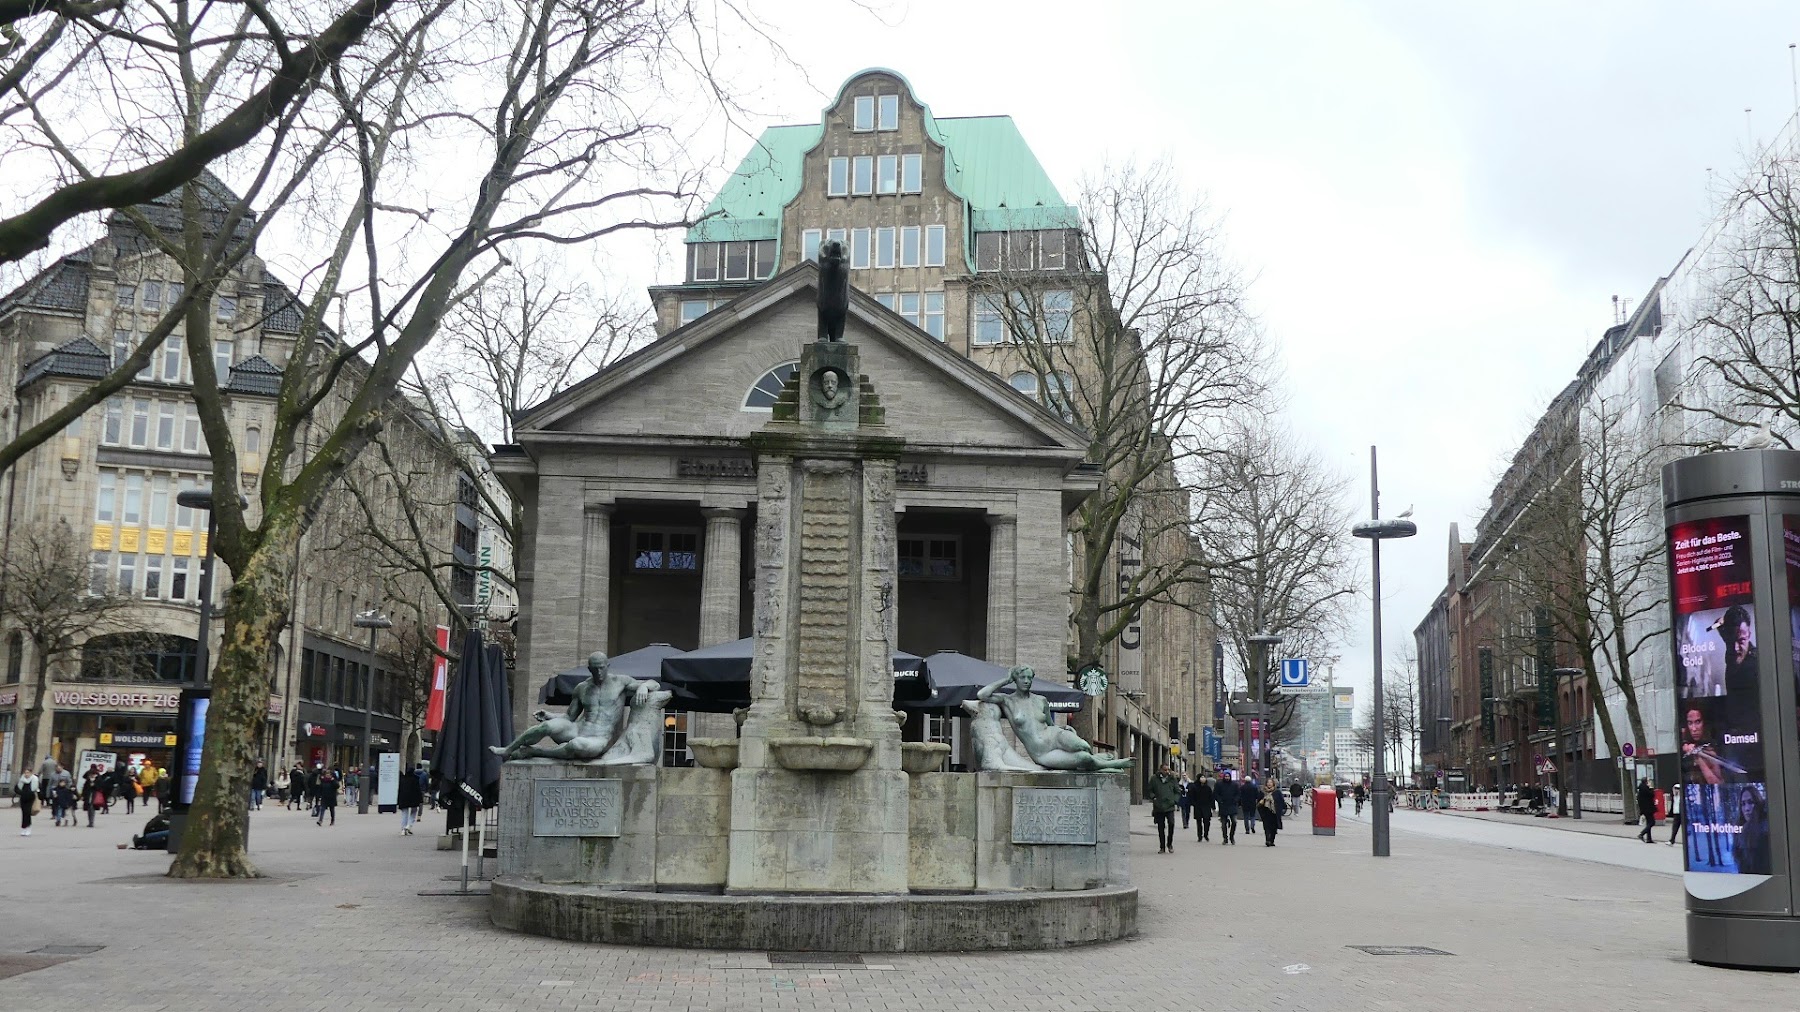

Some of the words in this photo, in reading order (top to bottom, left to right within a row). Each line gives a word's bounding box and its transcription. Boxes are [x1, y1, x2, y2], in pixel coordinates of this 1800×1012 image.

[1675, 540, 1690, 550] Zeit
[1690, 537, 1701, 547] für
[1702, 535, 1716, 546] das
[1717, 531, 1742, 543] Beste.
[1716, 581, 1751, 598] NETFLIX
[1683, 641, 1707, 654] Blood
[1709, 641, 1716, 651] &
[1683, 655, 1703, 666] Gold
[1284, 660, 1304, 683] U
[54, 691, 149, 707] WOLSDORFF
[153, 694, 180, 708] ZIG
[114, 735, 163, 744] WOLSDORFF
[1724, 732, 1758, 745] Damsel
[541, 786, 591, 797] GESTIFTET
[542, 797, 562, 808] DEN
[546, 808, 608, 818] HAMBURGS
[1692, 823, 1710, 834] The
[1710, 823, 1743, 834] Mother
